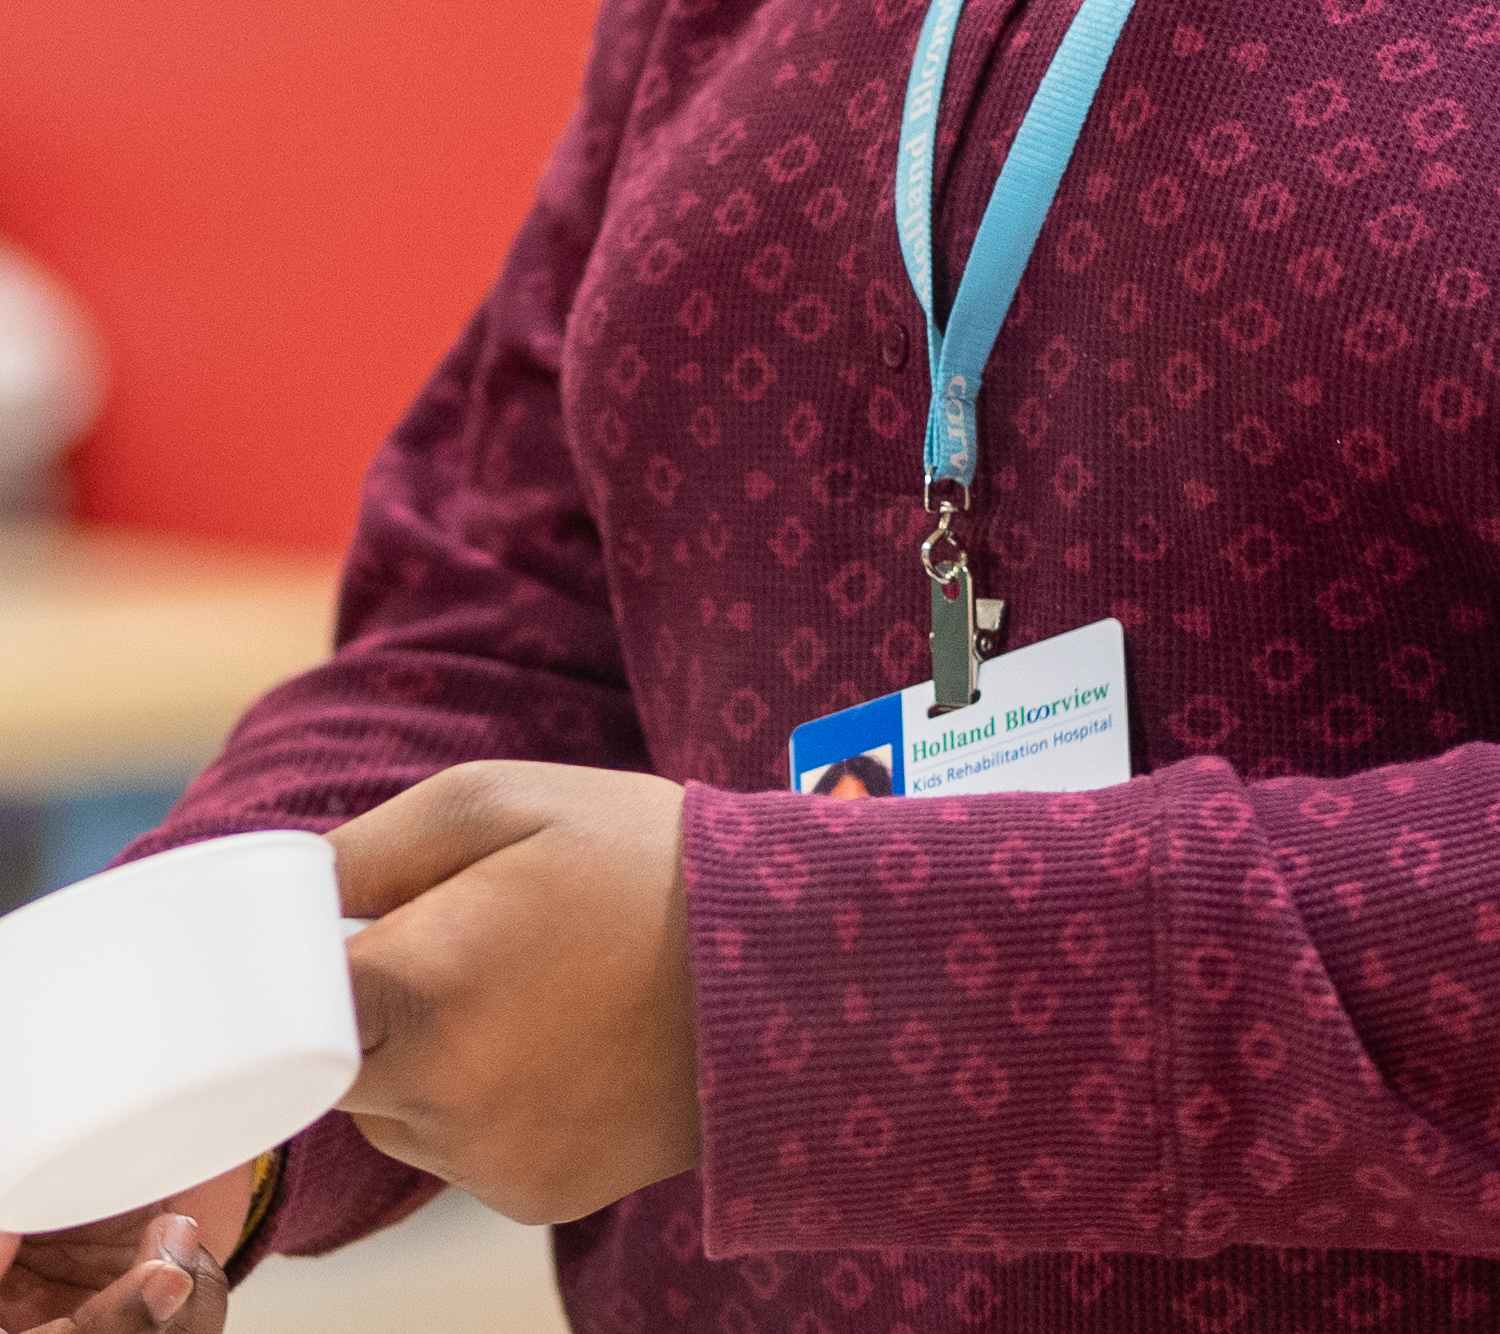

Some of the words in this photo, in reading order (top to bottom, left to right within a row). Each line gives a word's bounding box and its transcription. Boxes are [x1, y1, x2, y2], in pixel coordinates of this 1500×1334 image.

[911, 715, 996, 764] Holland
[1005, 681, 1110, 733] Bloorview
[912, 771, 943, 793] Kids
[946, 739, 1049, 782] Rehabilitation
[1052, 714, 1114, 753] Hospital
